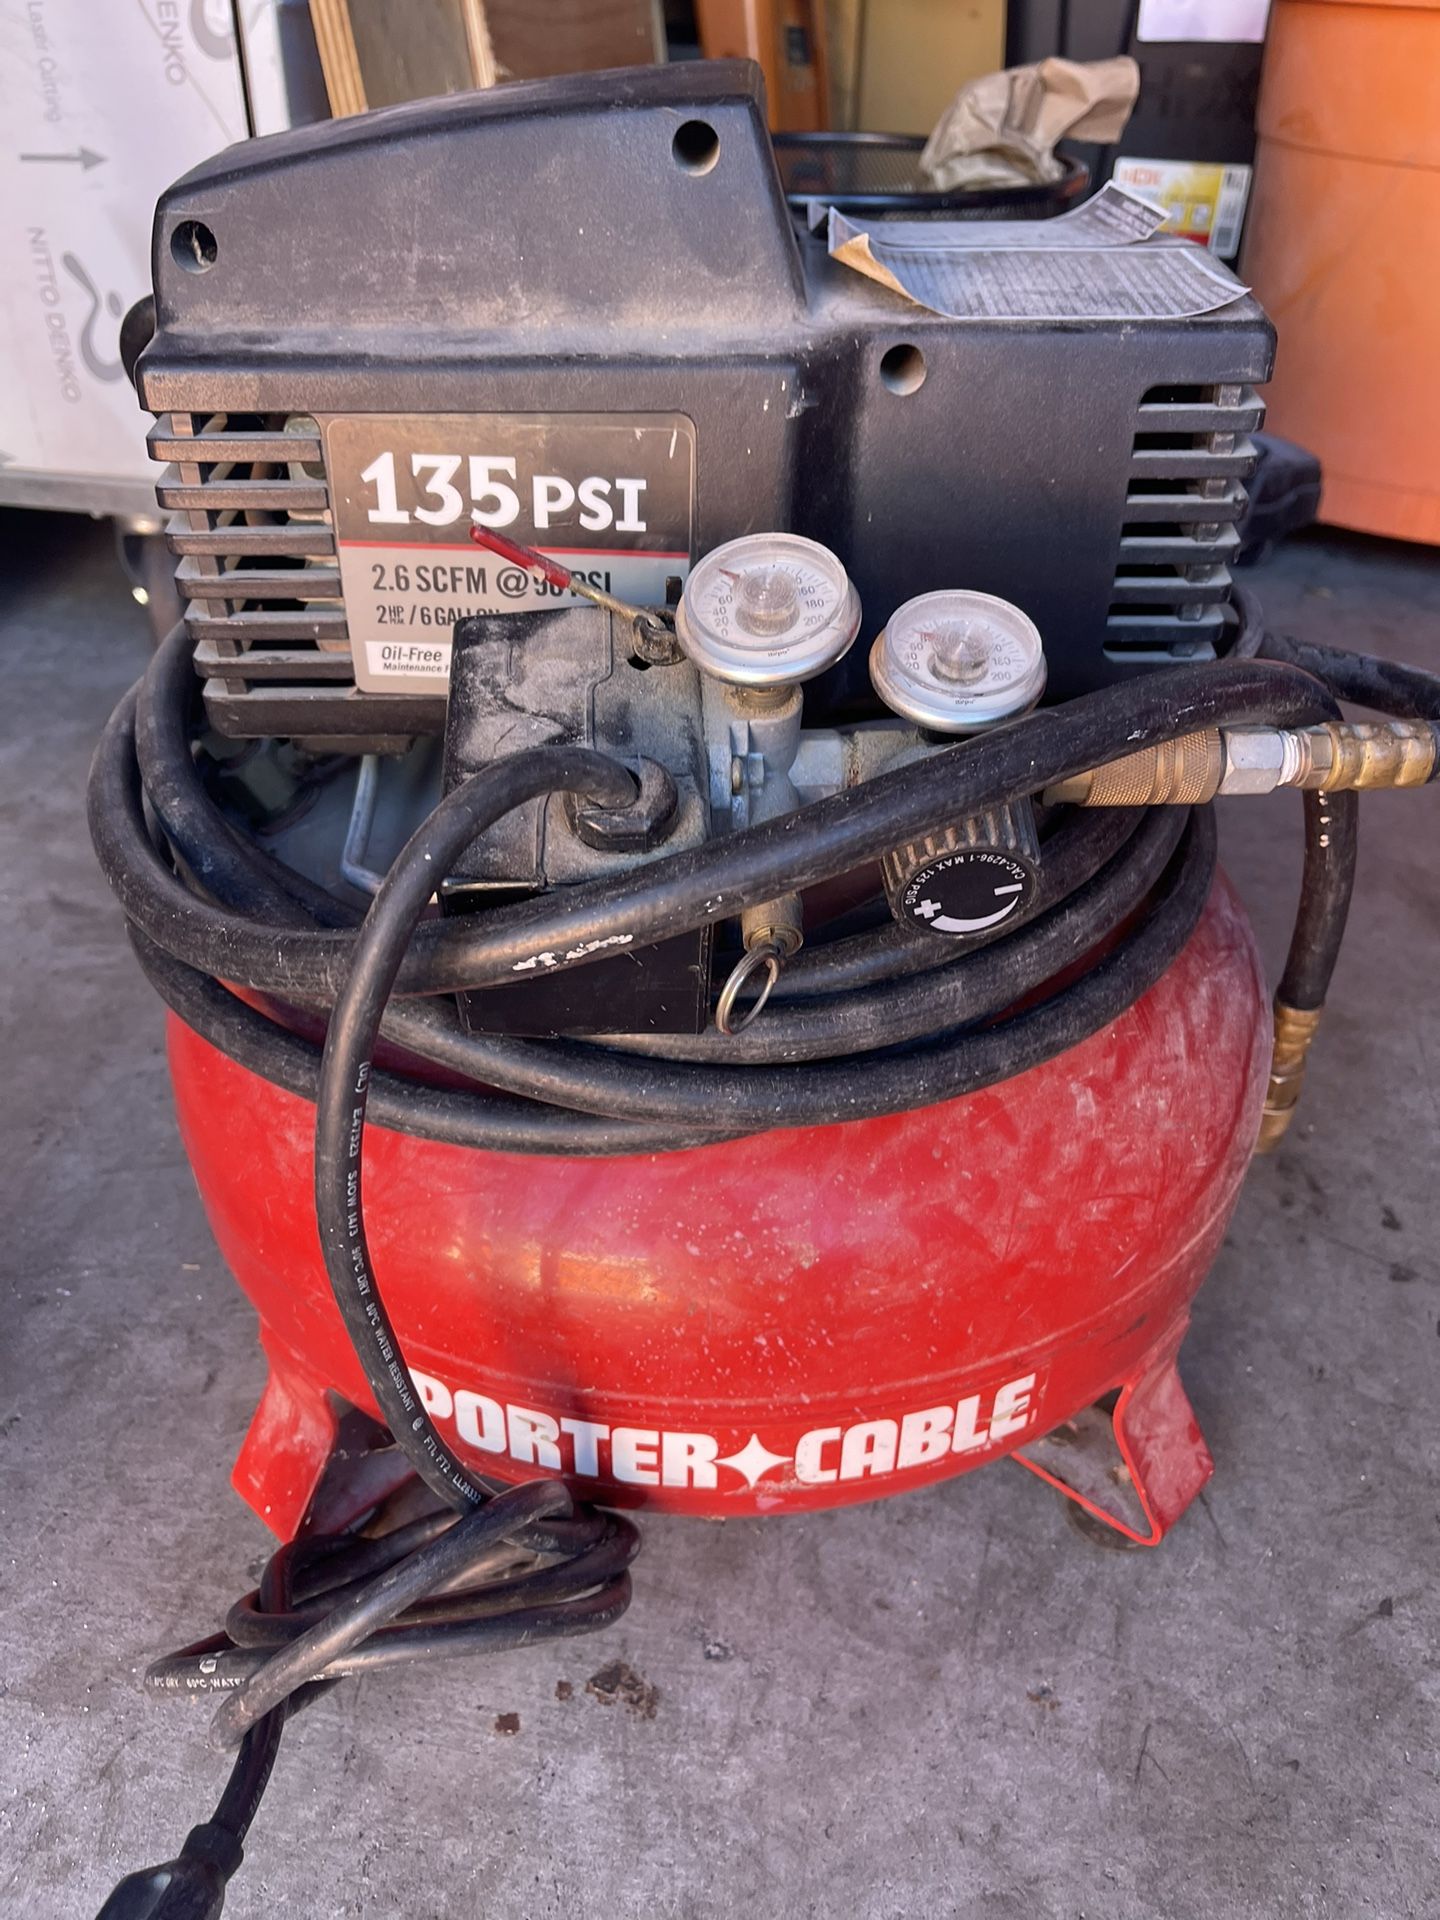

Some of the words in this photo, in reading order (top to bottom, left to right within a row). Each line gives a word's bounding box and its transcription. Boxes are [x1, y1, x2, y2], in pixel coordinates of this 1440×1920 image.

[26, 226, 59, 306] NITTO
[45, 311, 82, 404] DENKO
[360, 452, 520, 528] 135
[532, 475, 647, 532] PSI
[371, 563, 410, 592] 2.6
[416, 565, 487, 595] SCFM
[496, 566, 529, 598] @
[718, 594, 733, 606] 60
[805, 598, 825, 609] 180
[714, 616, 729, 627] 20
[720, 628, 728, 637] 0
[381, 645, 443, 661] Oil-Free
[383, 662, 442, 673] Maintenance
[935, 856, 965, 871] MAX
[915, 869, 935, 884] 125
[904, 884, 921, 905] PSIG
[355, 1061, 371, 1094] (UL)
[346, 1169, 358, 1207] SJOW
[347, 1211, 359, 1237] 14/3
[356, 1272, 371, 1295] DRY
[375, 1326, 394, 1362] WATER
[388, 1360, 416, 1412] RESISTANT
[408, 1366, 719, 1489] PORTER
[794, 1373, 1037, 1484] CABLE
[435, 1453, 452, 1474] FT2
